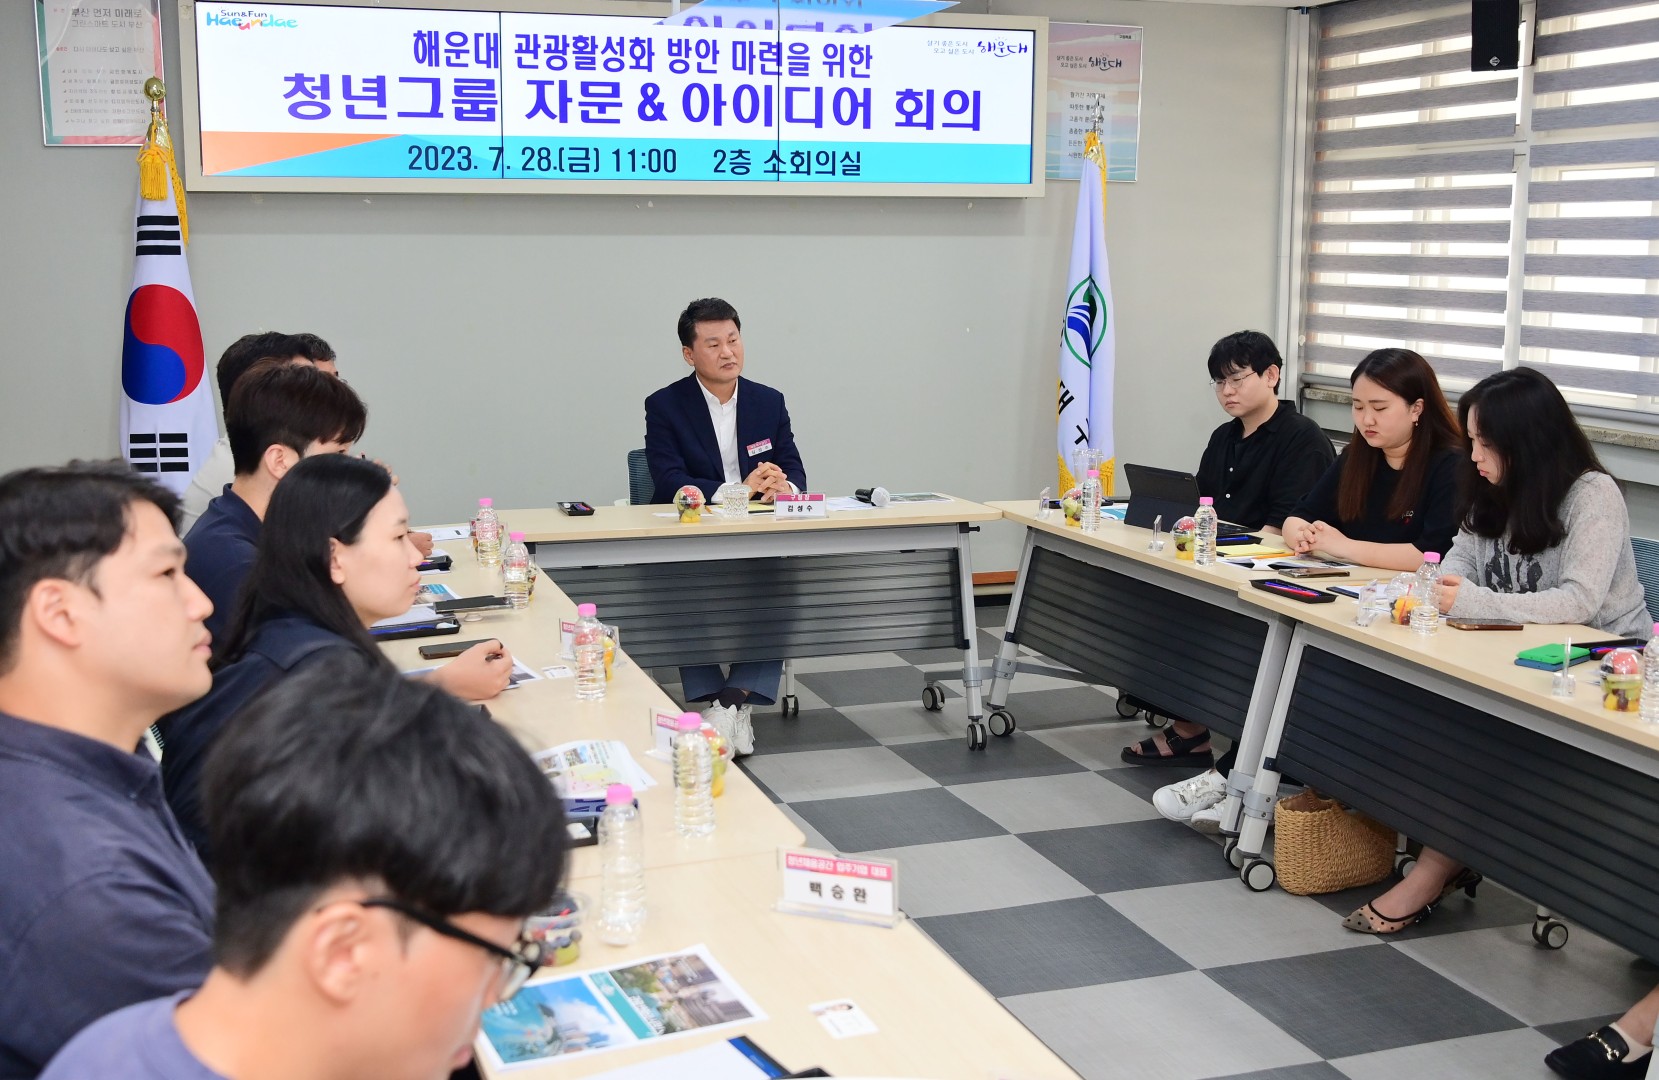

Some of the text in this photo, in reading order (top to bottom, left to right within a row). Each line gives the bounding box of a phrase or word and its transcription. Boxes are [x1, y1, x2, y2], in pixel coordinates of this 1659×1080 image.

[93, 8, 112, 18] 먼저
[206, 11, 299, 31] Haeundae
[220, 9, 268, 18] Sun&Fun
[414, 30, 872, 78] 해운대 관광활성화 방안 마련을 위한
[976, 40, 1028, 58] 해운대
[1088, 56, 1122, 71] 해운대
[283, 73, 981, 131] 청년그룹 자문 & 아이디어 회의
[409, 145, 478, 171] 2023.
[489, 146, 514, 172] 7.
[612, 149, 676, 173] 11:00
[714, 149, 752, 175] 2층
[764, 150, 861, 177] 소회의실
[870, 866, 888, 878] 대표
